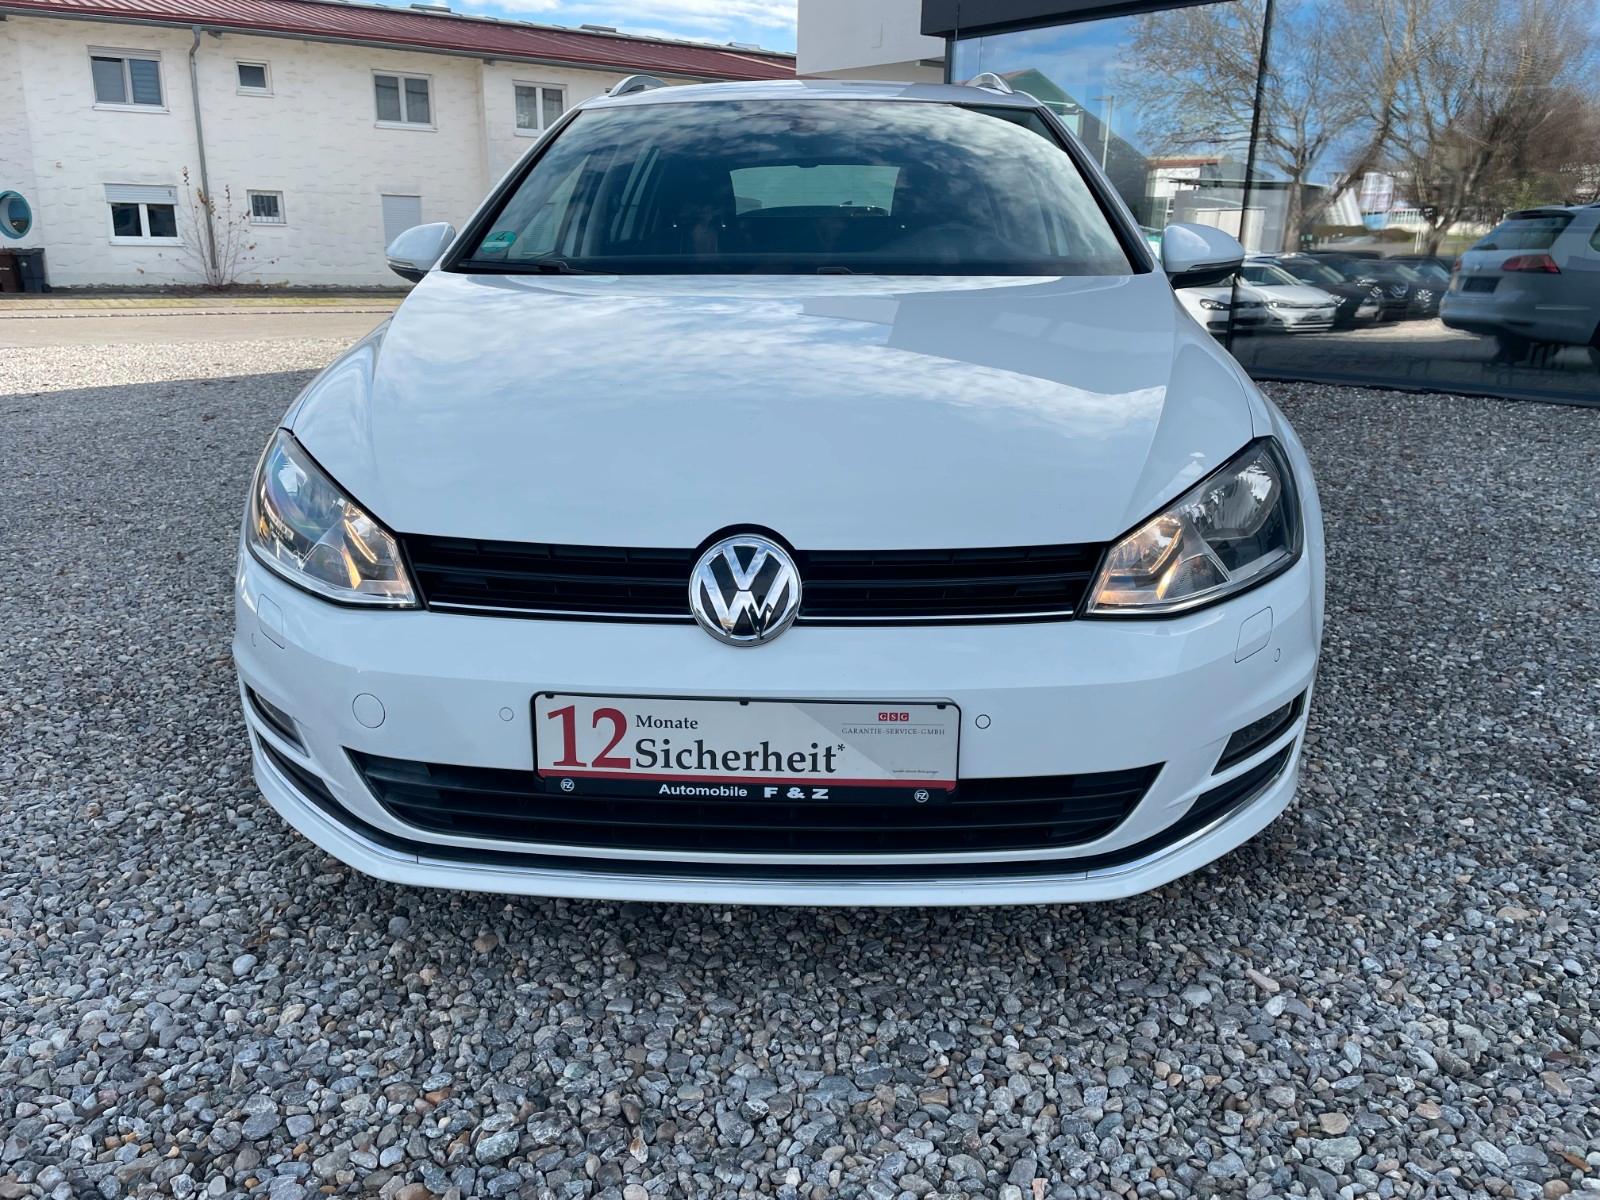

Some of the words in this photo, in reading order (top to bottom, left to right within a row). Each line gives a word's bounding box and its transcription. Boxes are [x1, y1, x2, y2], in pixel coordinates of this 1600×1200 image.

[697, 542, 793, 639] VW
[635, 714, 699, 729] Monate
[879, 712, 909, 721] GSG
[547, 705, 631, 769] 12
[658, 783, 748, 797] Automobile
[763, 786, 779, 798] F
[786, 786, 806, 799] &
[811, 788, 829, 799] Z
